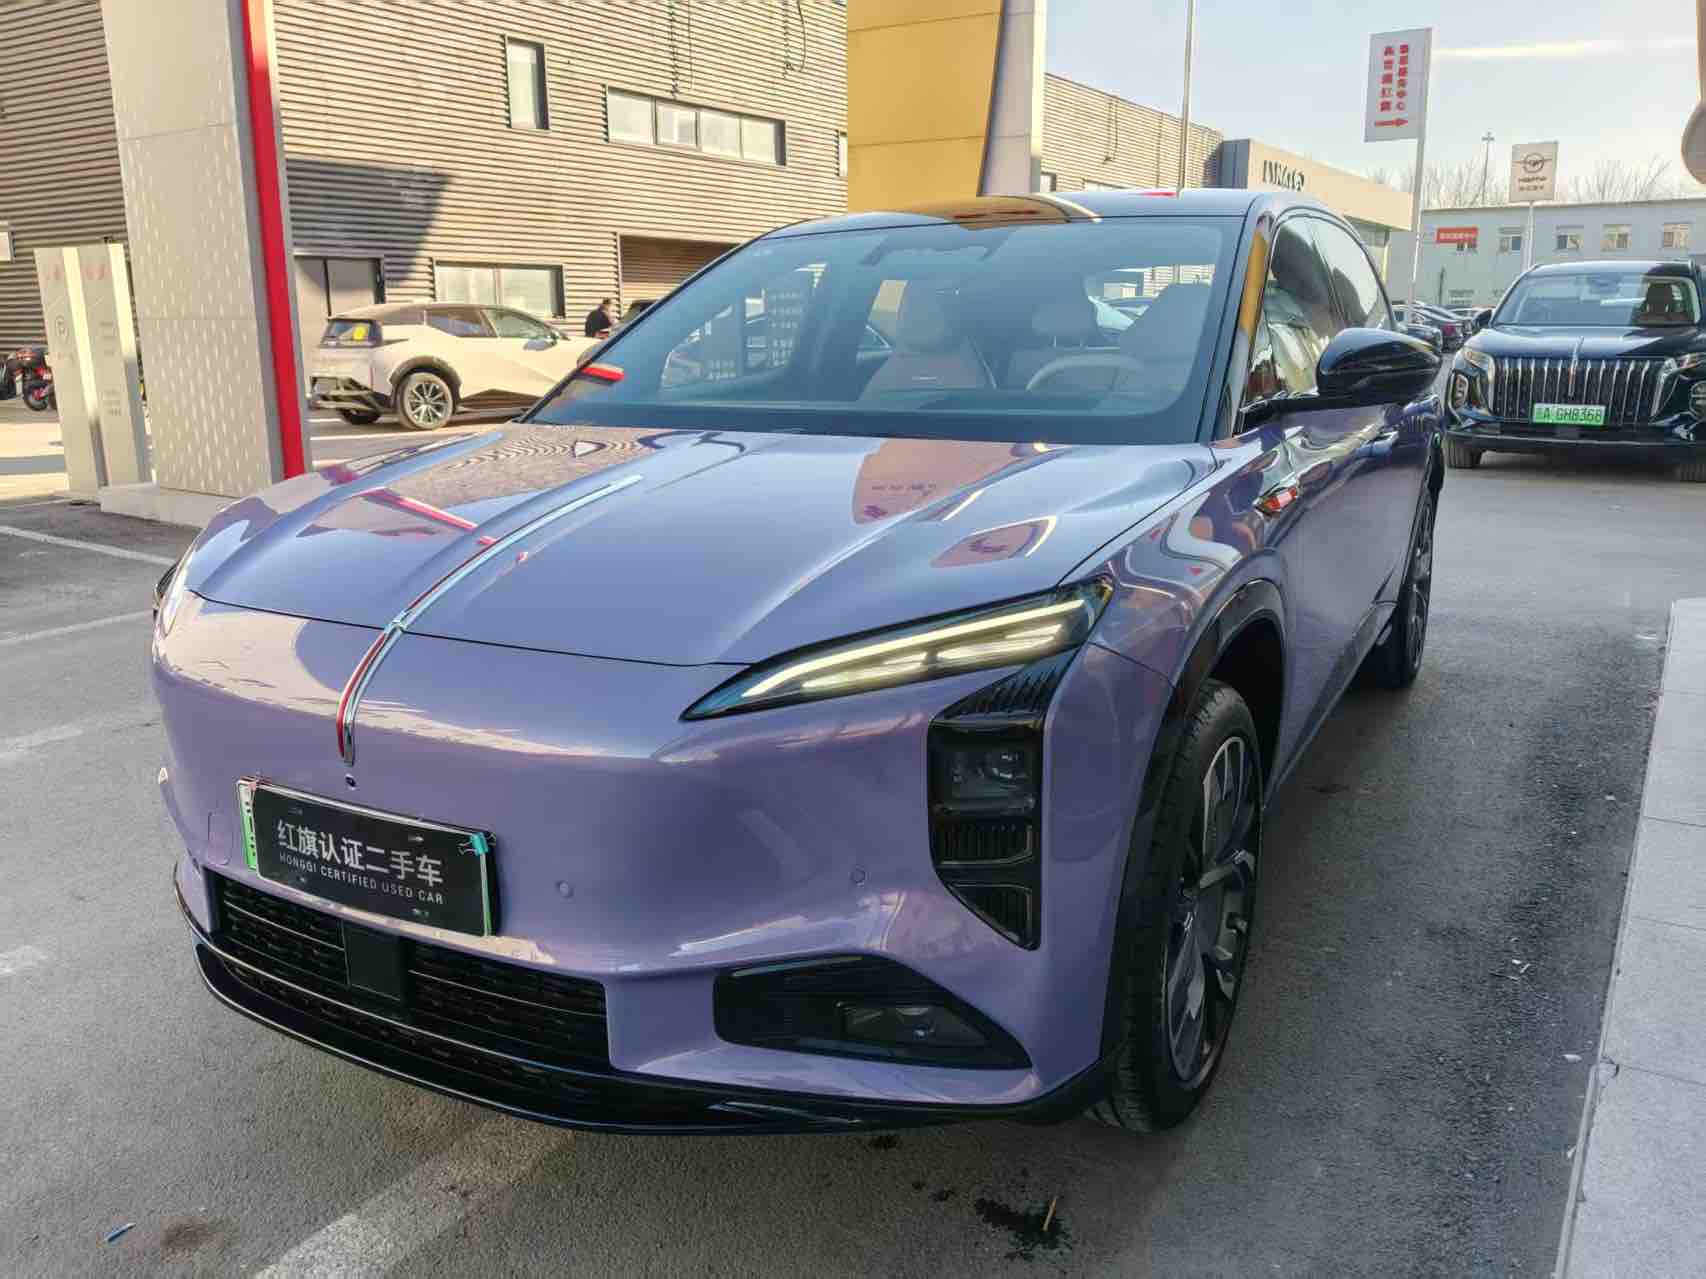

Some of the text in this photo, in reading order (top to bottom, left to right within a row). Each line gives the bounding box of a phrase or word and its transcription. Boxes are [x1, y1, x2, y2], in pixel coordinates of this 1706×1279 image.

[277, 818, 443, 887] 红旗认证二手车
[279, 851, 444, 905] HONGQI CERTIFIED USED CAR
